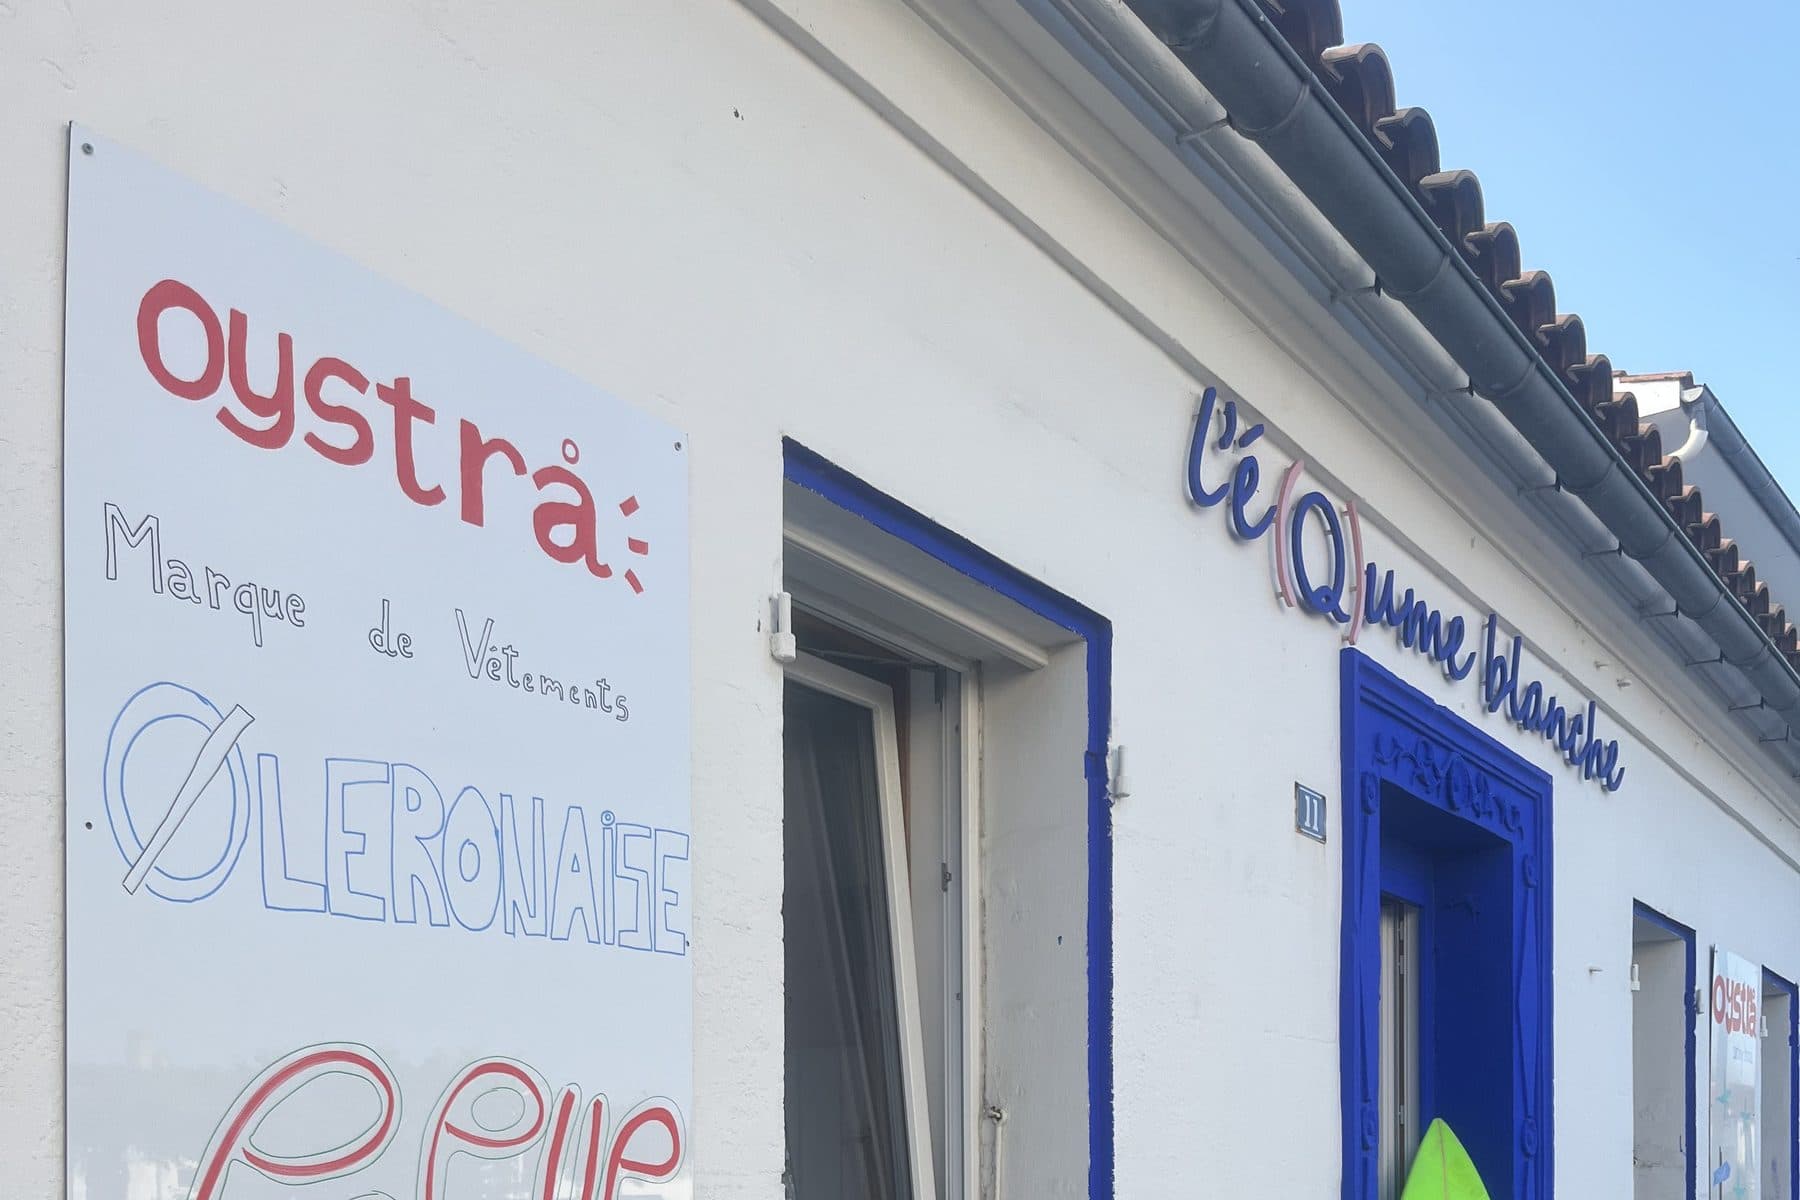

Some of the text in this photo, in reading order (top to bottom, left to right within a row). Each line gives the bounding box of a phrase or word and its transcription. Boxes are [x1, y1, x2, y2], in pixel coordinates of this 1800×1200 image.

[103, 501, 306, 648] Marque
[367, 598, 414, 659] de
[1484, 612, 1625, 792] blanche
[1304, 794, 1319, 833] 11
